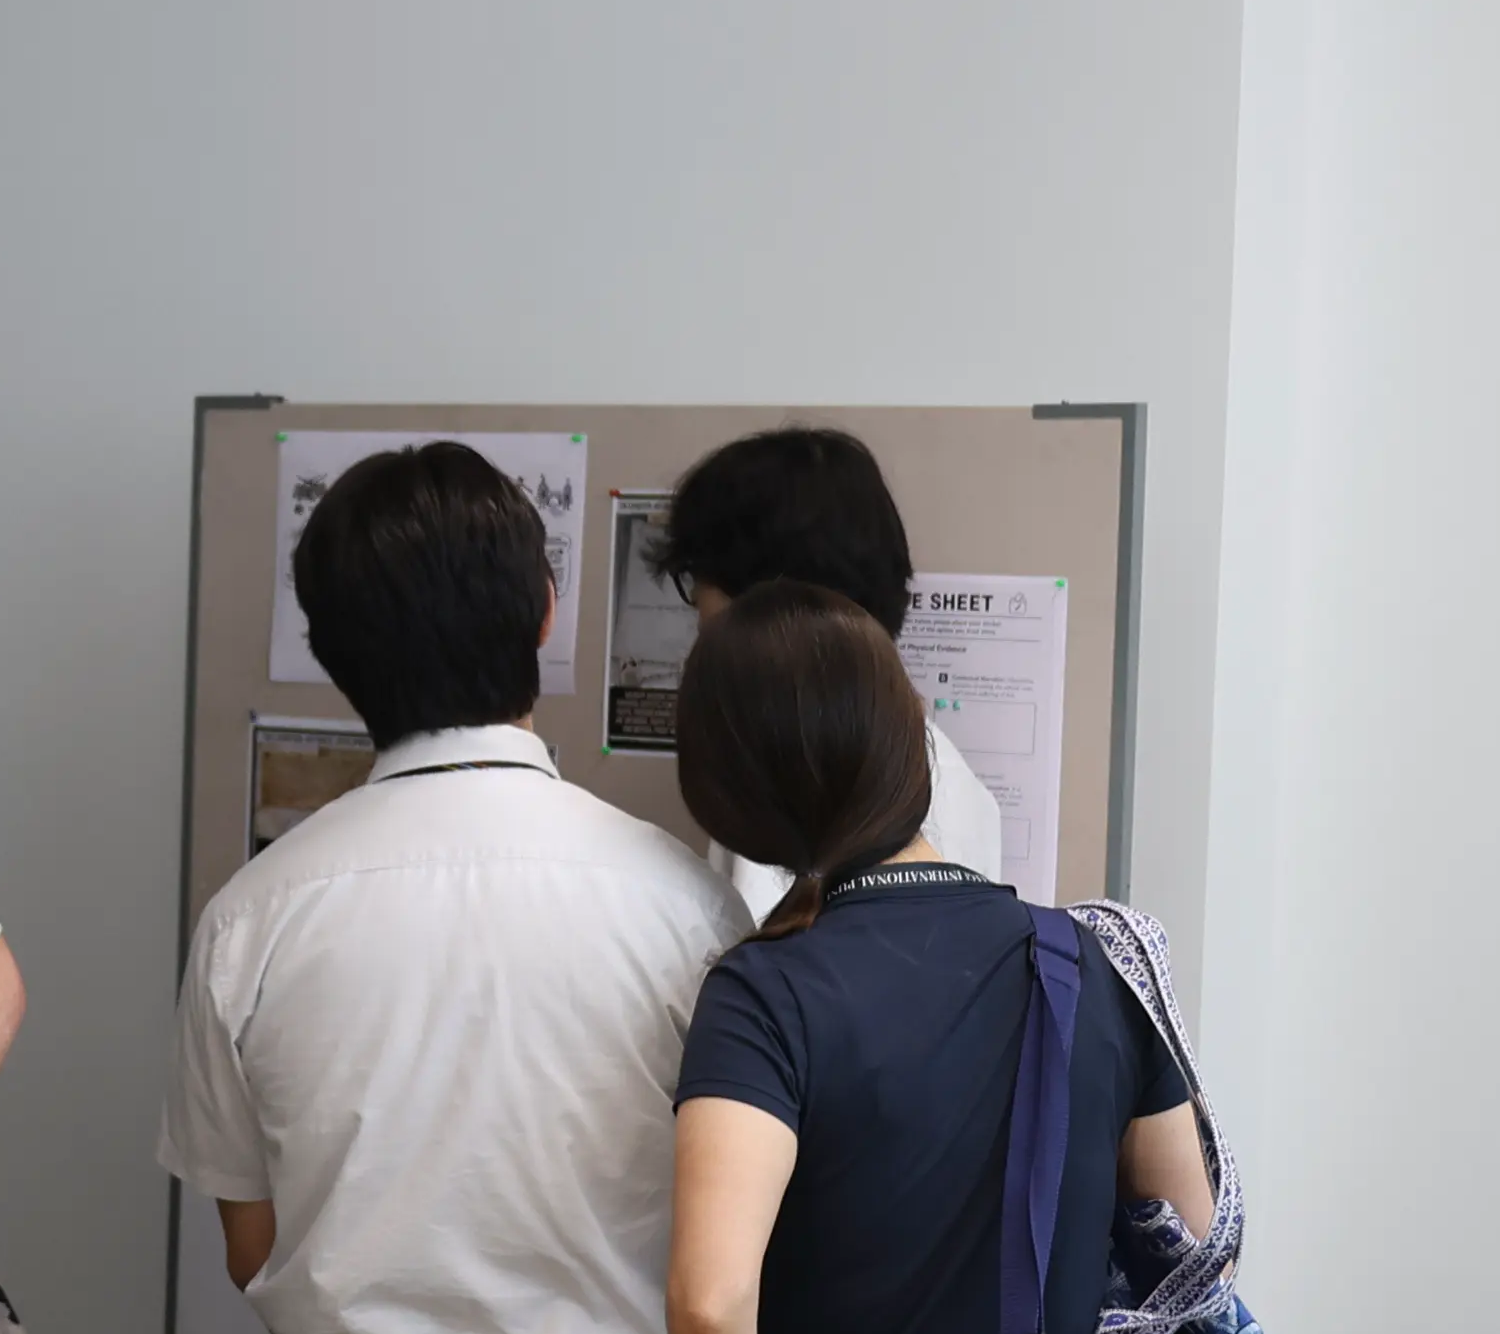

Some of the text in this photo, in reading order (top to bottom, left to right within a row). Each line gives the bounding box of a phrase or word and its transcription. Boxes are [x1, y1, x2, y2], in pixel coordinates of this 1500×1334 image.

[930, 592, 994, 612] SHEET
[907, 644, 935, 653] Physical
[936, 644, 966, 653] Evidence
[858, 869, 963, 887] INTERNATIONAL
